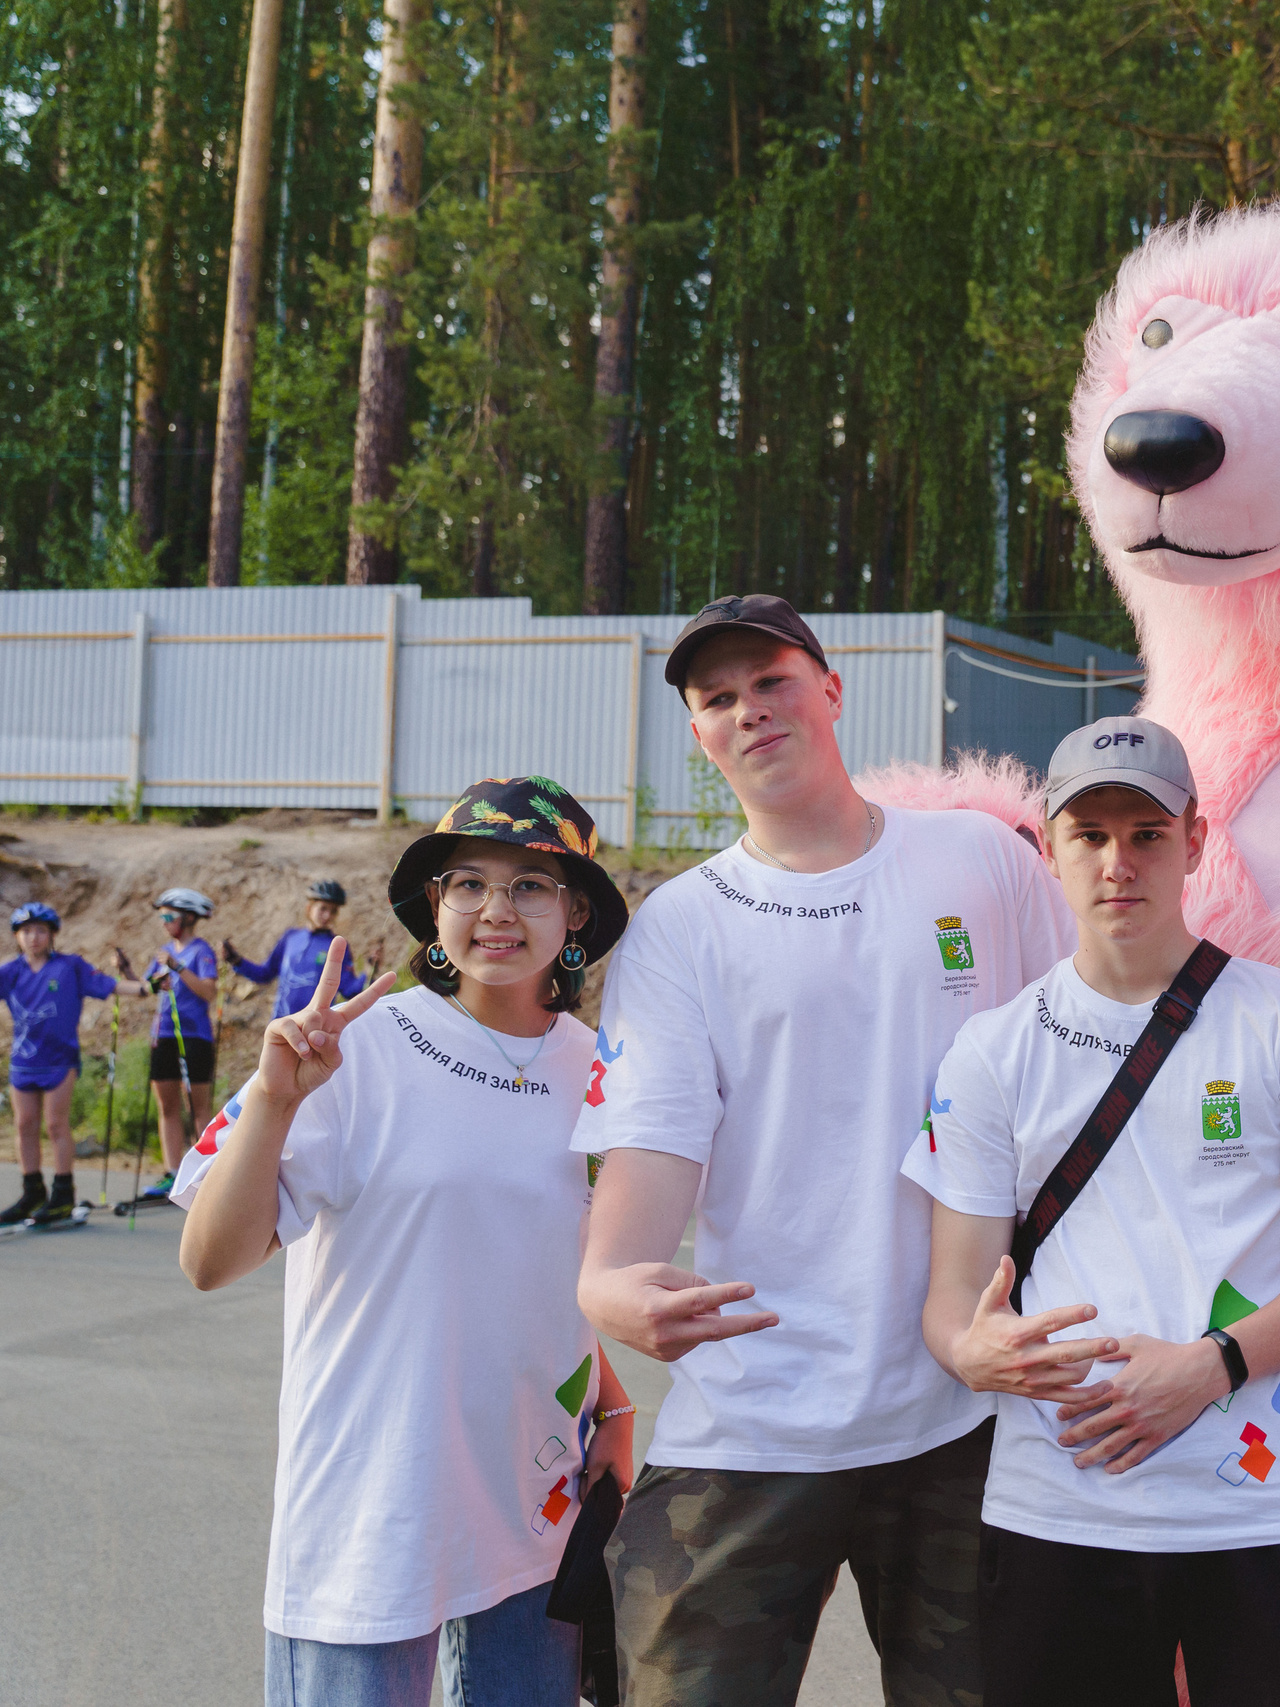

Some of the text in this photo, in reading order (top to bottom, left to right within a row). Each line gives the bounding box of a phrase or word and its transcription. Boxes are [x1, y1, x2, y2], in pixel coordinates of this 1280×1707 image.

[1093, 733, 1145, 749] OFF
[755, 902, 792, 916] ДЛЯ
[797, 901, 862, 919] ЗАВТРА
[386, 1005, 551, 1095] #СЕГОДНЯ ДЛЯ ЗАВТРА
[1069, 1031, 1103, 1048] ДЛЯ
[1103, 1039, 1134, 1057] ЗАВ
[1127, 1033, 1164, 1086] NIKE
[1094, 1087, 1132, 1141] NIKE
[1061, 1138, 1099, 1189] NIKE
[1198, 1153, 1231, 1161] городской
[1203, 1144, 1244, 1153] Березовский
[1033, 1190, 1063, 1237] NIKE
